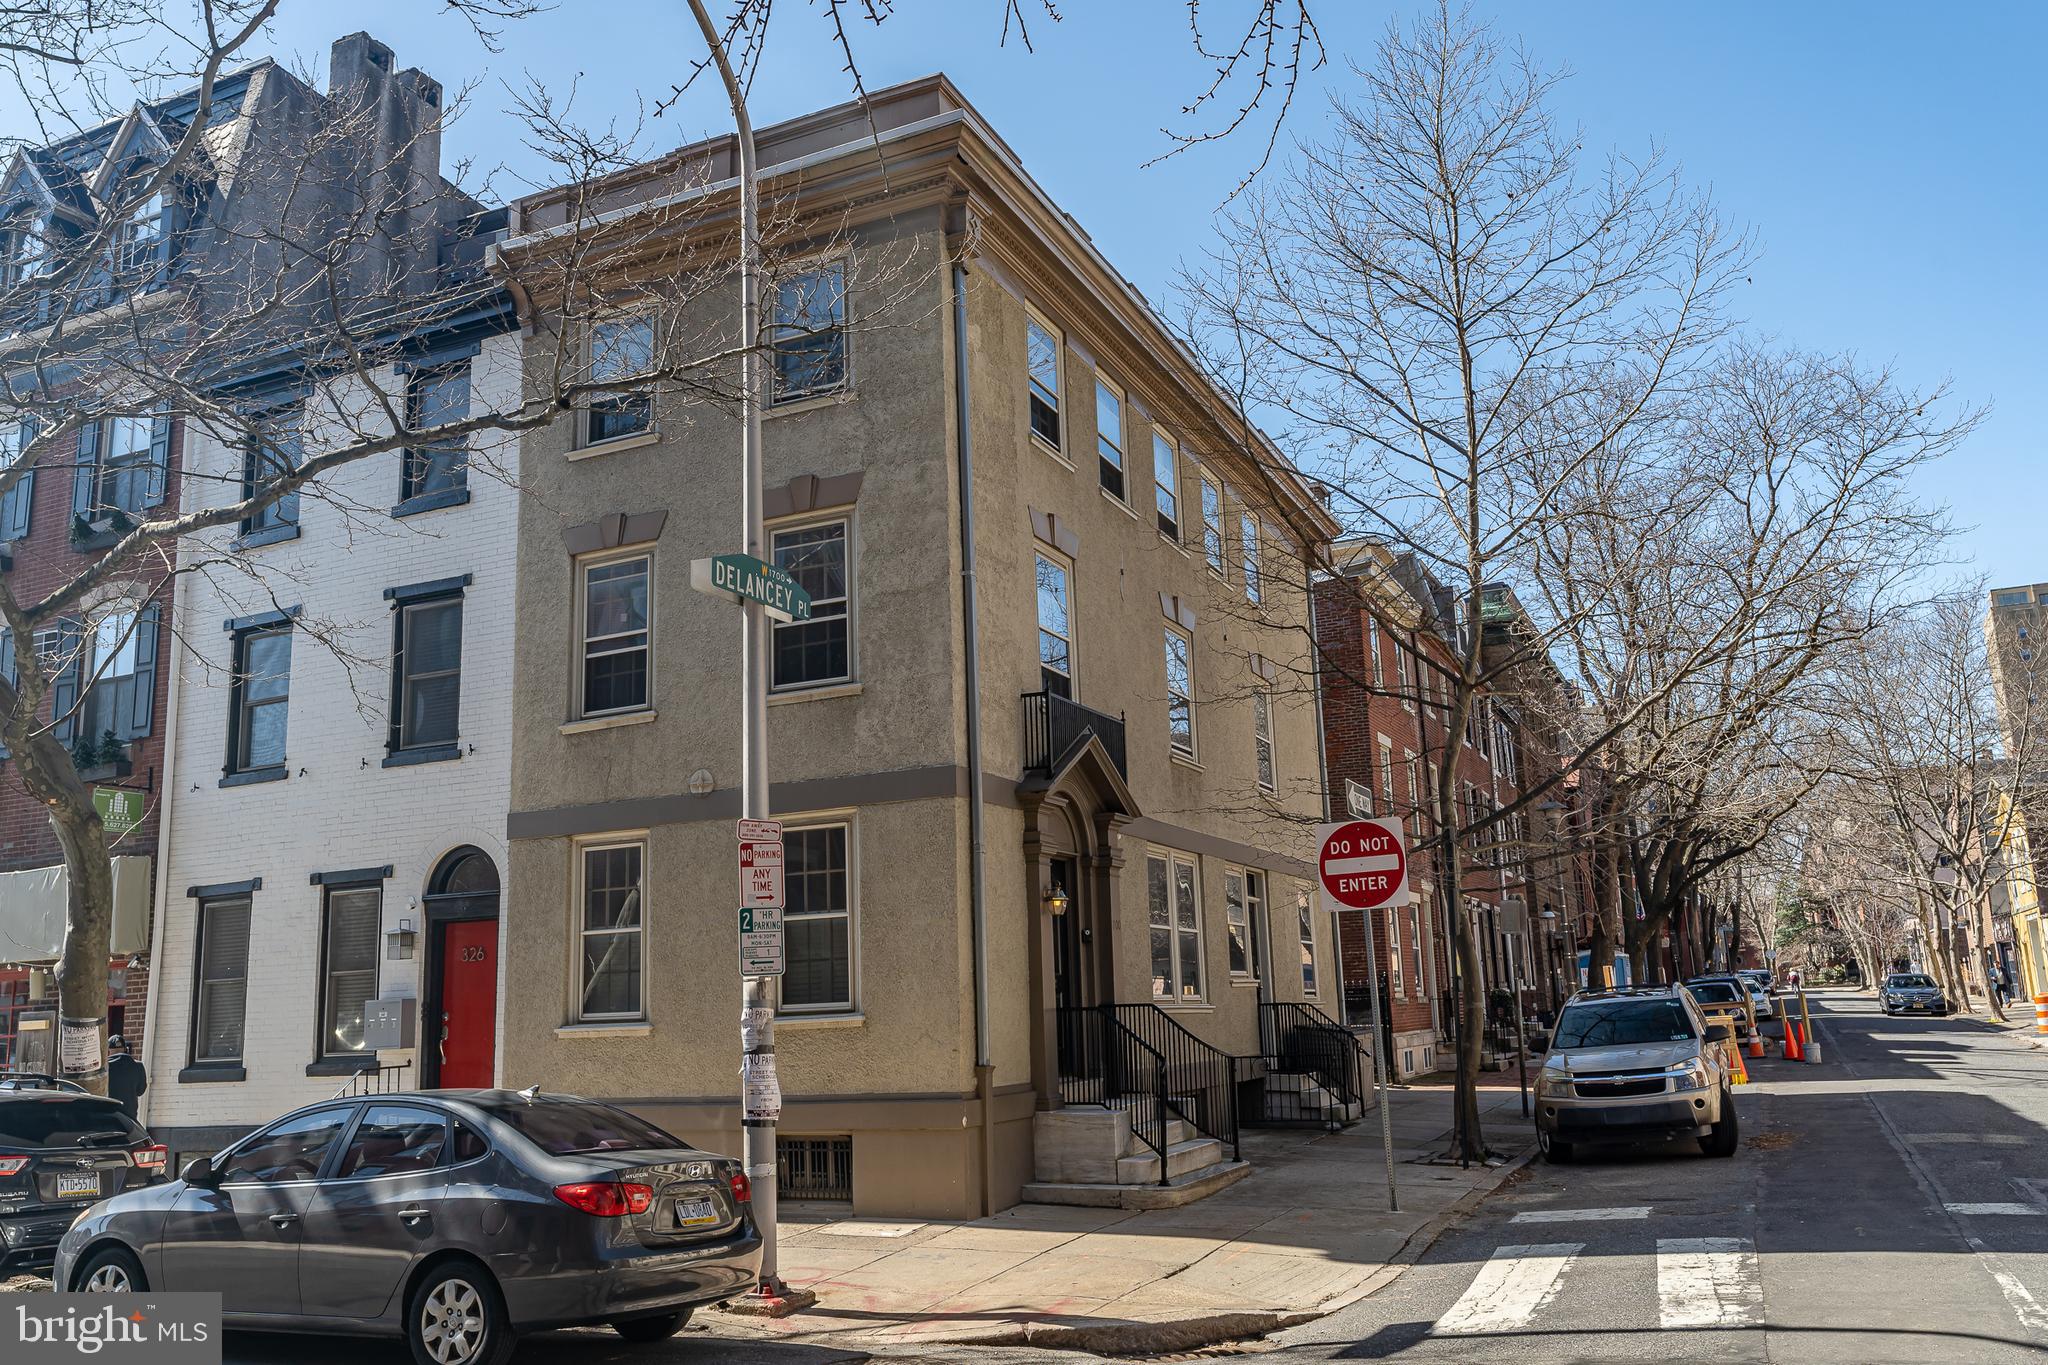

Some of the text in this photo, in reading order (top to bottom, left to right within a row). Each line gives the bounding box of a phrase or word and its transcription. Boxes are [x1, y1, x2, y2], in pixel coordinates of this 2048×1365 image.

[761, 563, 785, 583] W 1700
[715, 560, 809, 618] DELANCEY PL
[1330, 836, 1389, 855] DO NOT
[741, 849, 781, 862] NO PARKING
[752, 868, 771, 879] ANY
[752, 880, 773, 892] TIME
[1339, 875, 1388, 893] ENTER
[742, 912, 751, 930] 2
[762, 911, 774, 920] HR
[753, 921, 781, 930] PARKING
[461, 947, 485, 962] 326
[749, 1053, 760, 1066] NO
